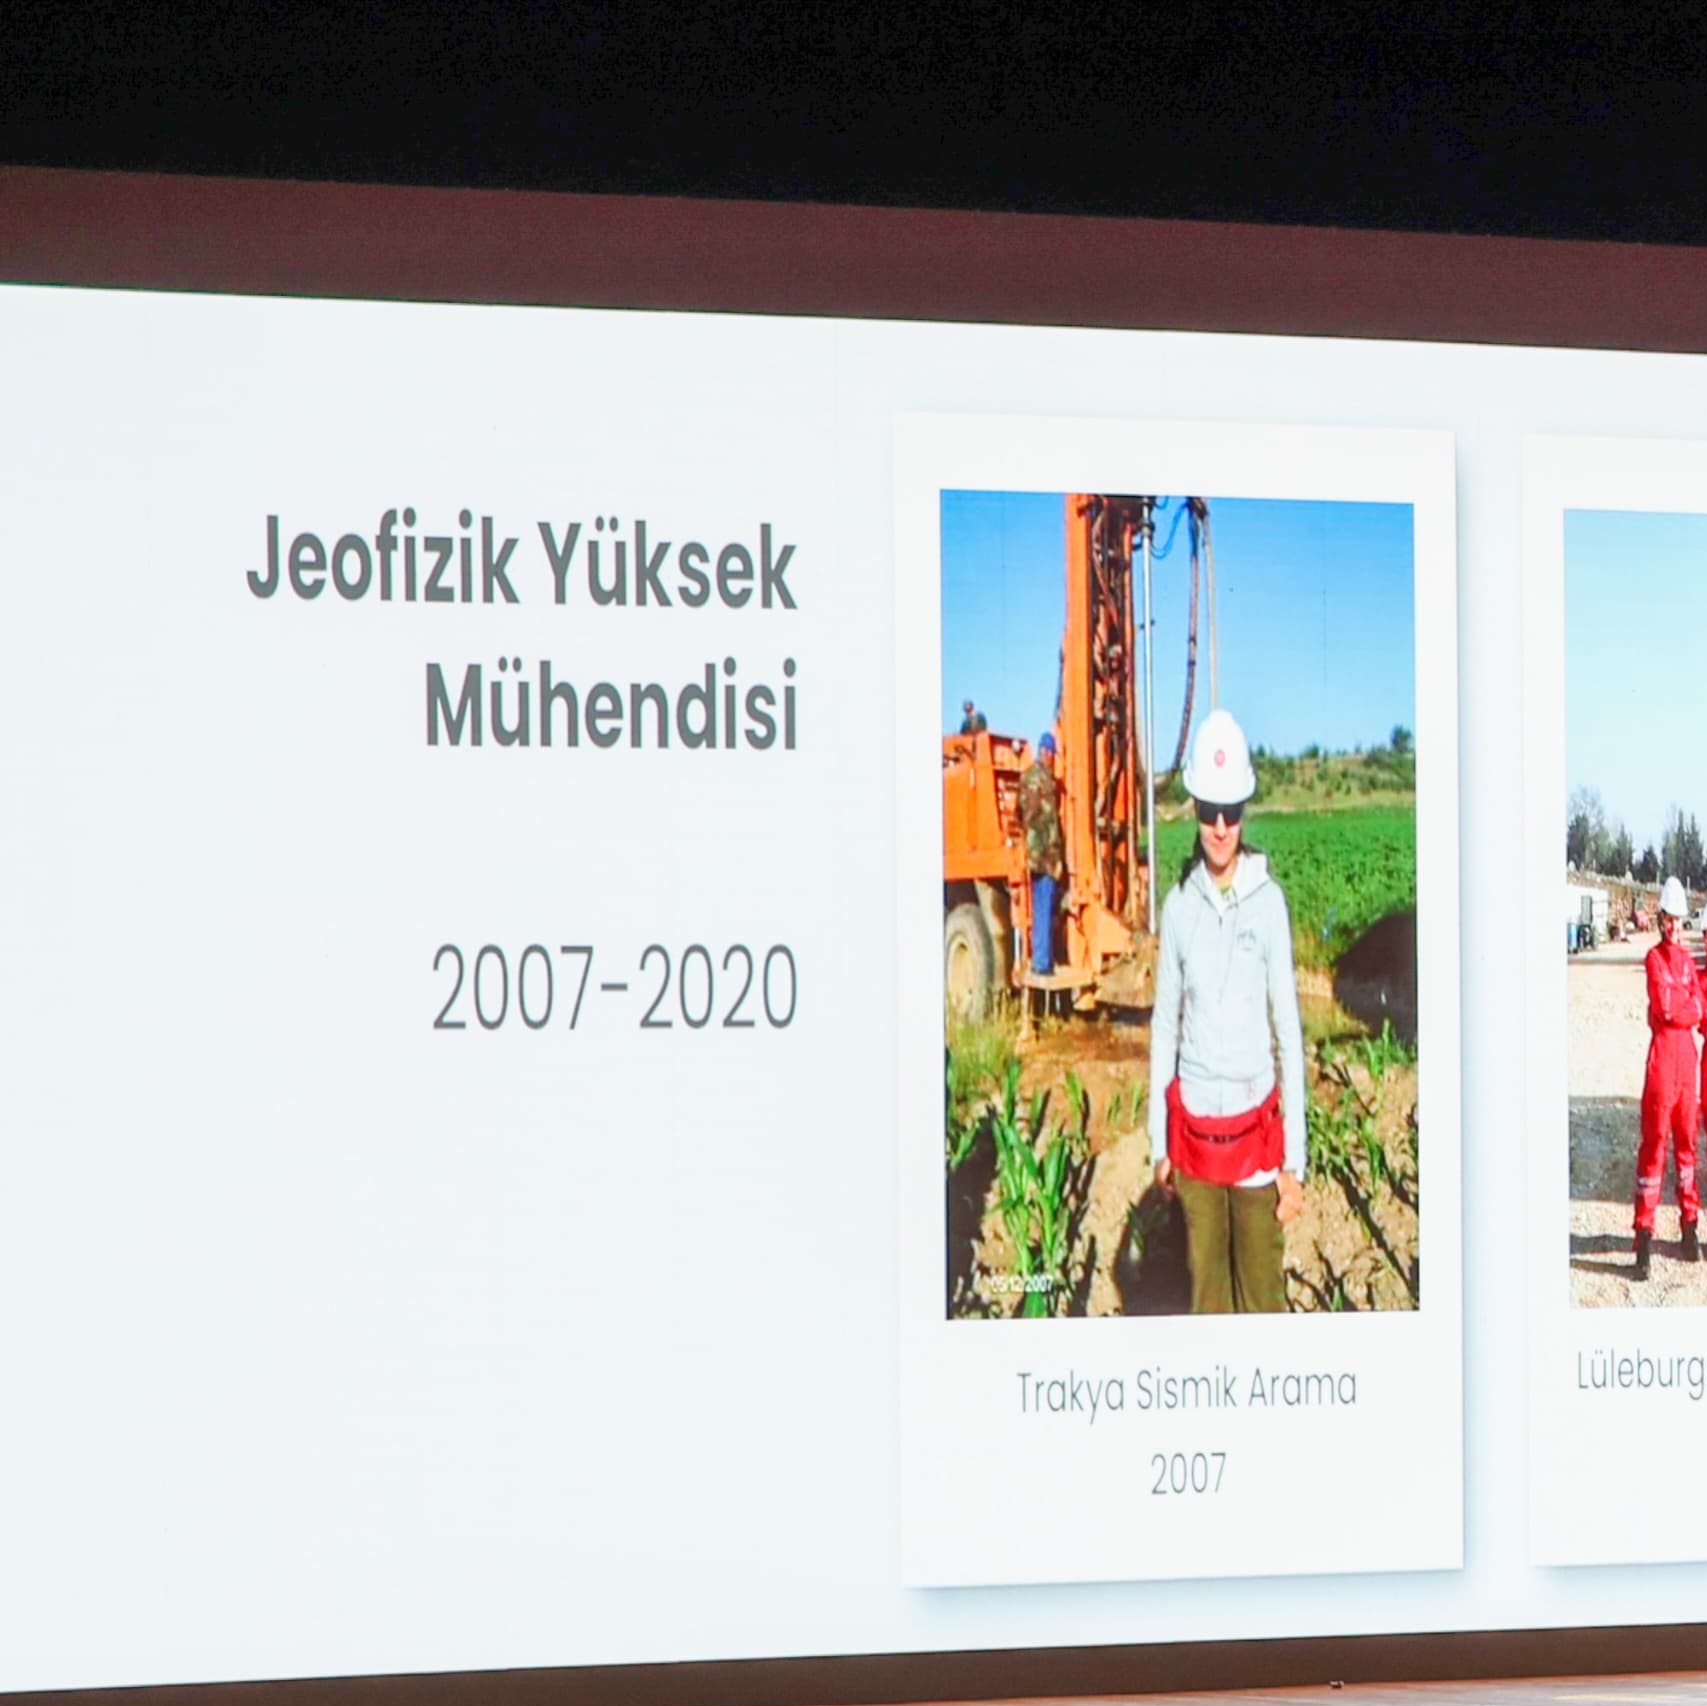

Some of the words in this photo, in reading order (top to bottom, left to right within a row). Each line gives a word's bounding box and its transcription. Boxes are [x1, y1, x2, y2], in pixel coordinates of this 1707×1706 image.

[245, 506, 520, 603] Jeofizik
[537, 515, 798, 610] Yüksek
[425, 655, 797, 750] Mühendisi
[431, 943, 798, 1031] 2007-2020
[1016, 1369, 1125, 1426] Trakya
[1136, 1365, 1238, 1411] Sismik
[1248, 1367, 1357, 1407] Arama
[1150, 1452, 1227, 1496] 2007
